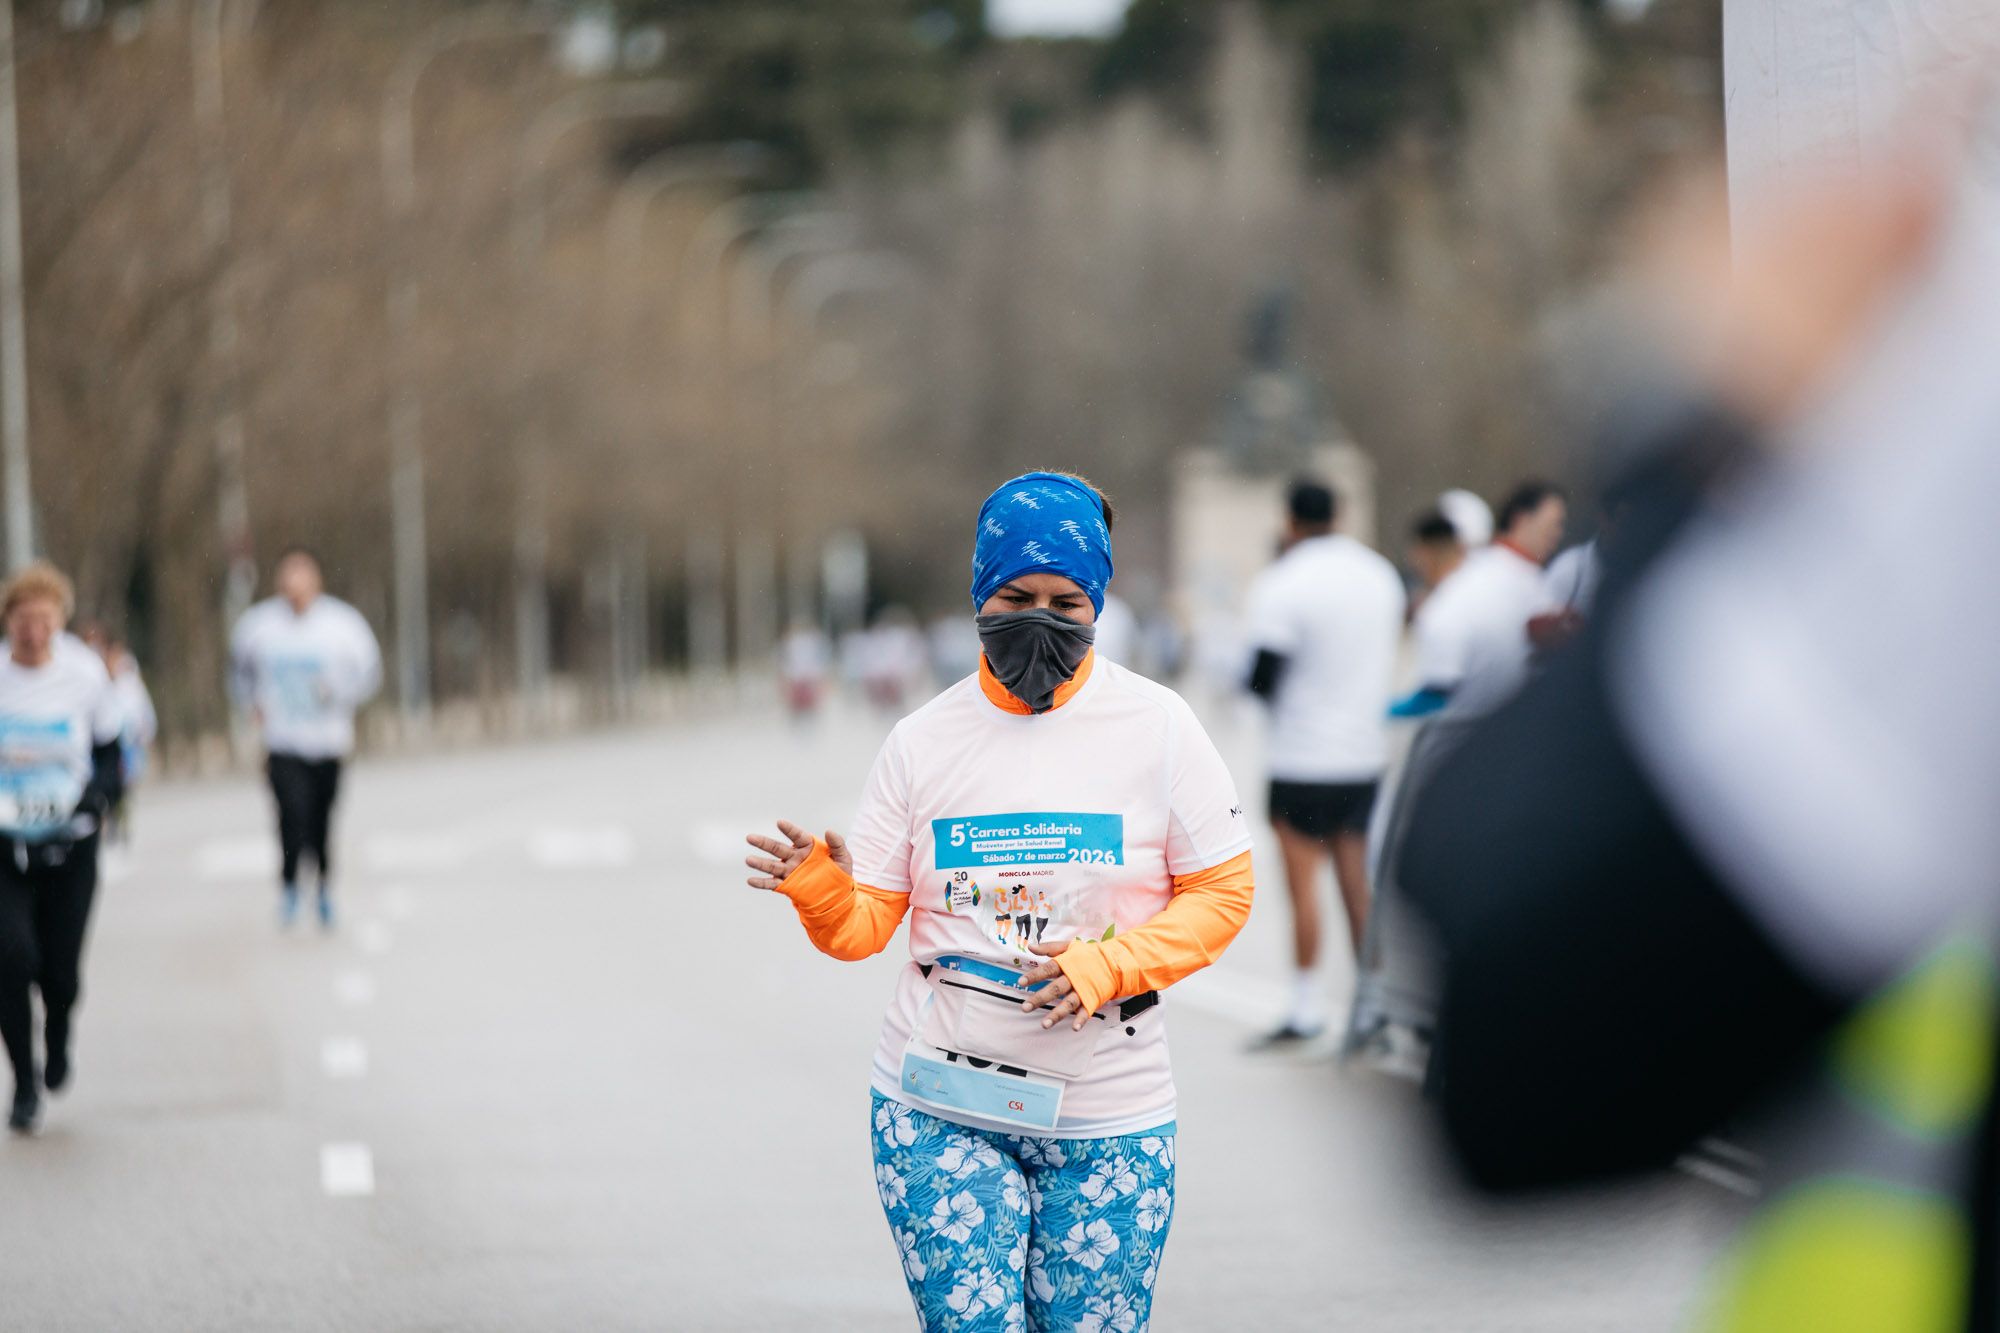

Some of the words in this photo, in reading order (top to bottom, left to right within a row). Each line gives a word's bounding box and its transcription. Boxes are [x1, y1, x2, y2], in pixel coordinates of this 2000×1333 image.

[969, 826, 1020, 839] Carrera
[1023, 823, 1083, 835] Solidaria
[1005, 841, 1015, 849] por
[982, 853, 1015, 863] Sábado
[1016, 852, 1022, 861] 7
[1024, 852, 1036, 861] de
[1068, 848, 1116, 865] 2026
[954, 871, 968, 881] 20
[1008, 1100, 1025, 1112] CSL
